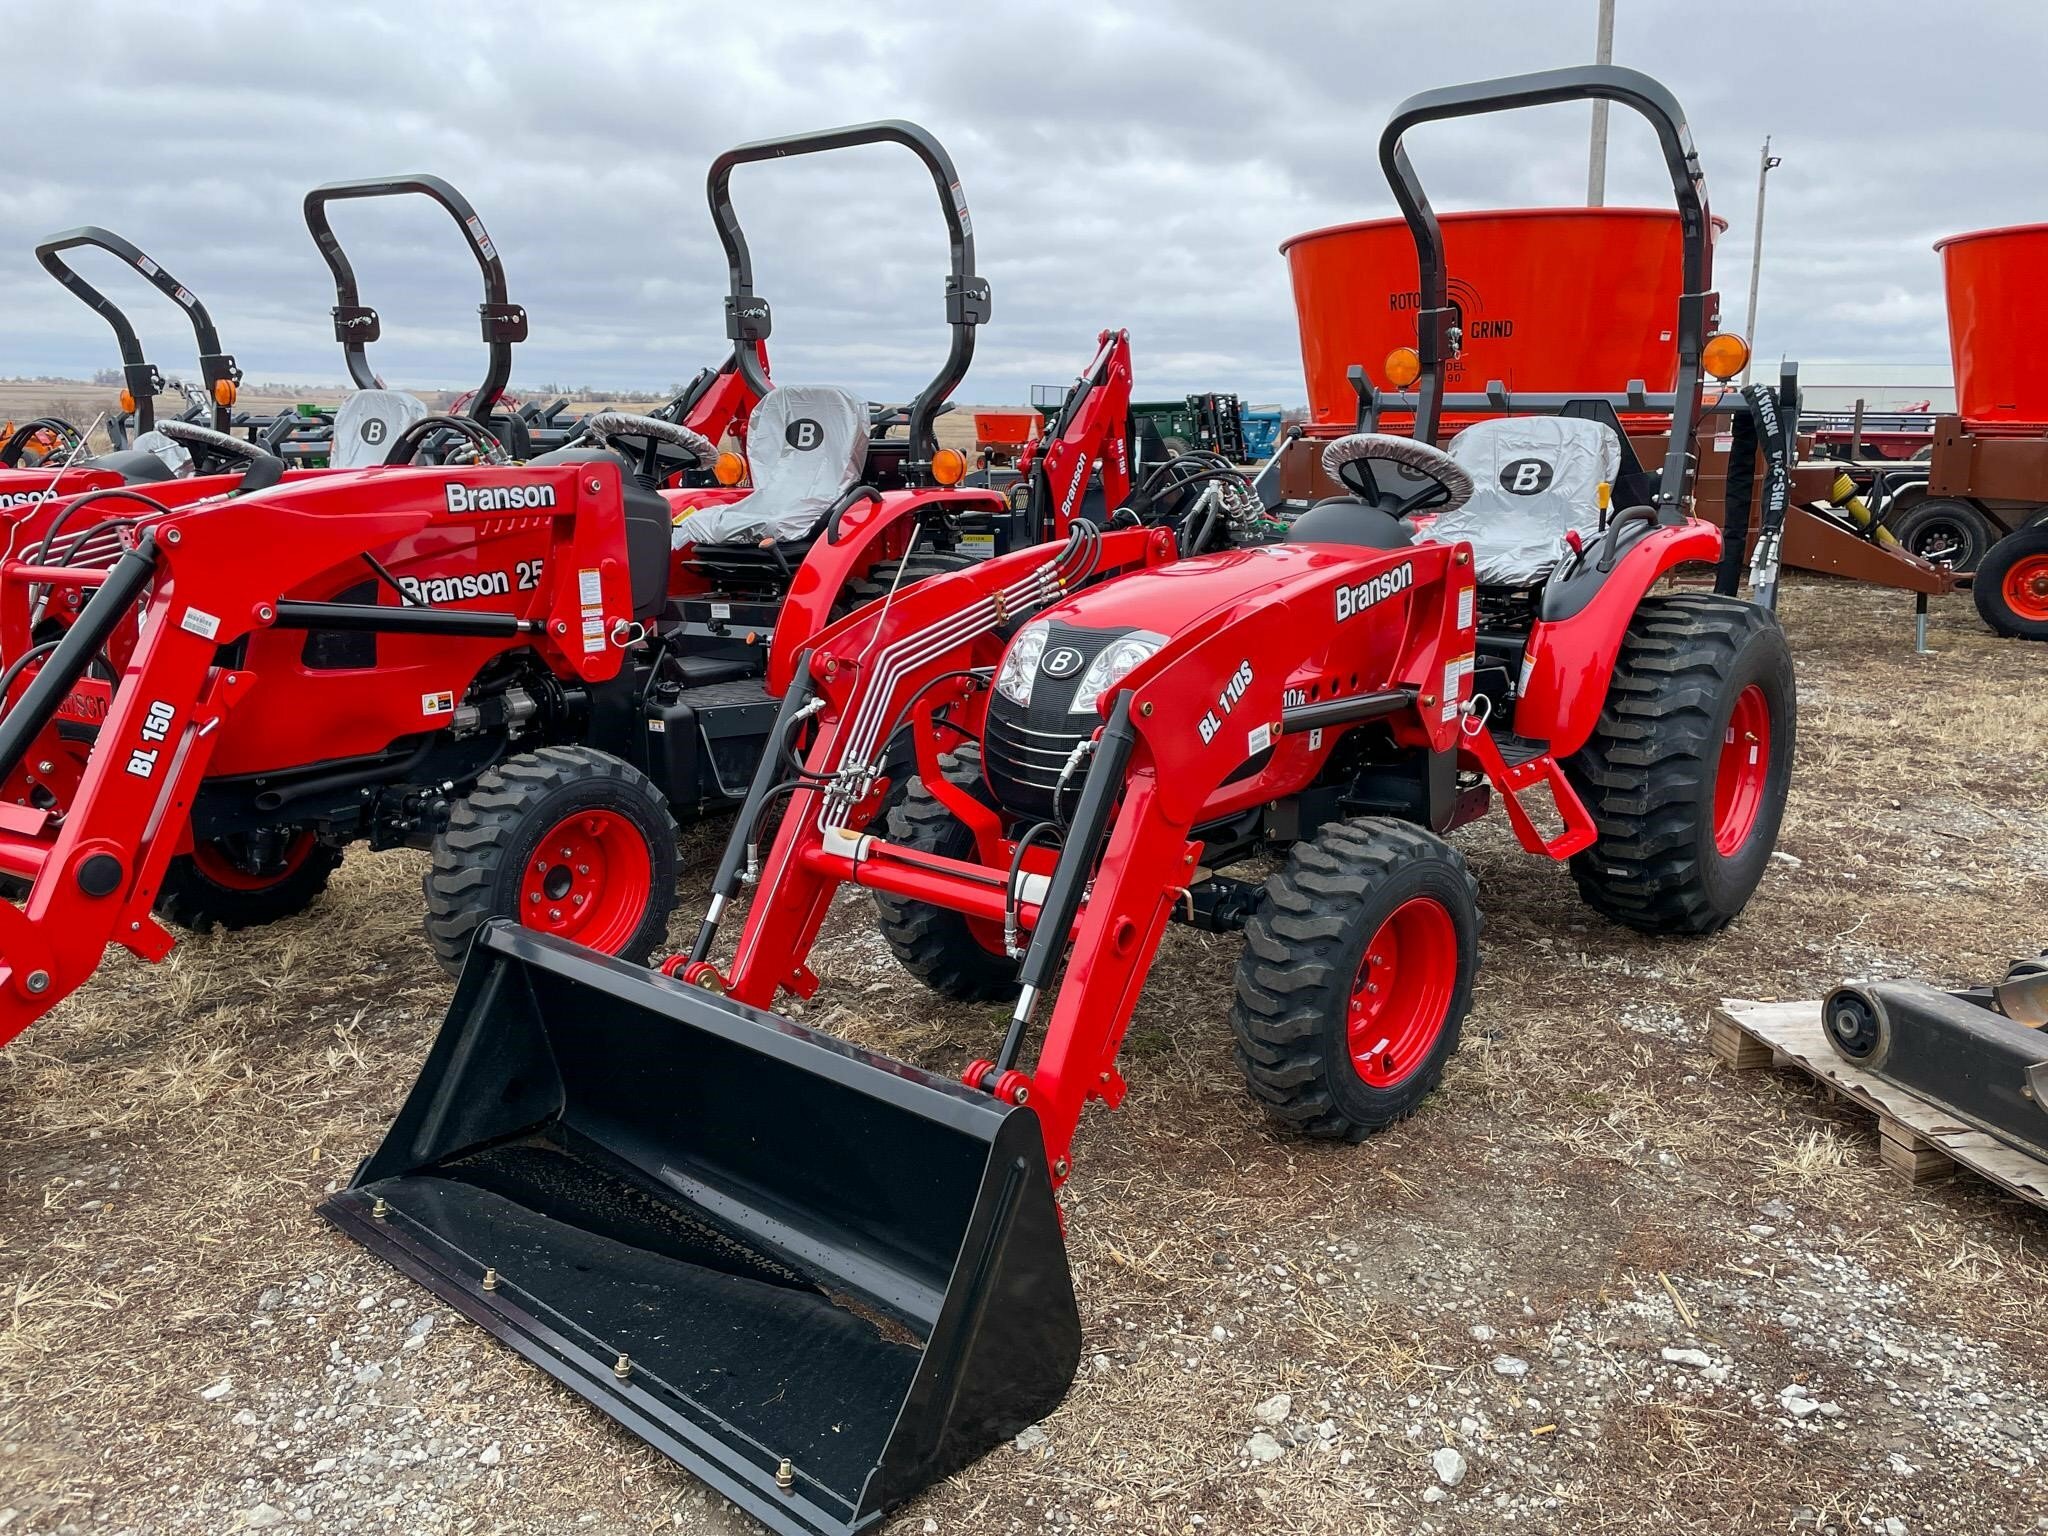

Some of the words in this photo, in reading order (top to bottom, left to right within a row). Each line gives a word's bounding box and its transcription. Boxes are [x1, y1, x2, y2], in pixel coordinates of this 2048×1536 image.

[1389, 292, 1420, 311] ROTO
[1470, 320, 1513, 338] GRIND
[1758, 395, 1779, 437] MSHA
[367, 422, 382, 442] B
[797, 423, 815, 447] B
[1061, 452, 1087, 517] Branson
[1512, 463, 1542, 491] B
[445, 483, 556, 513] Branson
[398, 571, 510, 608] Branson
[1335, 561, 1413, 623] Branson
[1049, 650, 1073, 671] B
[1198, 709, 1222, 745] BL
[1218, 659, 1254, 715] 110S
[142, 700, 176, 741] 150
[126, 749, 159, 778] BL
